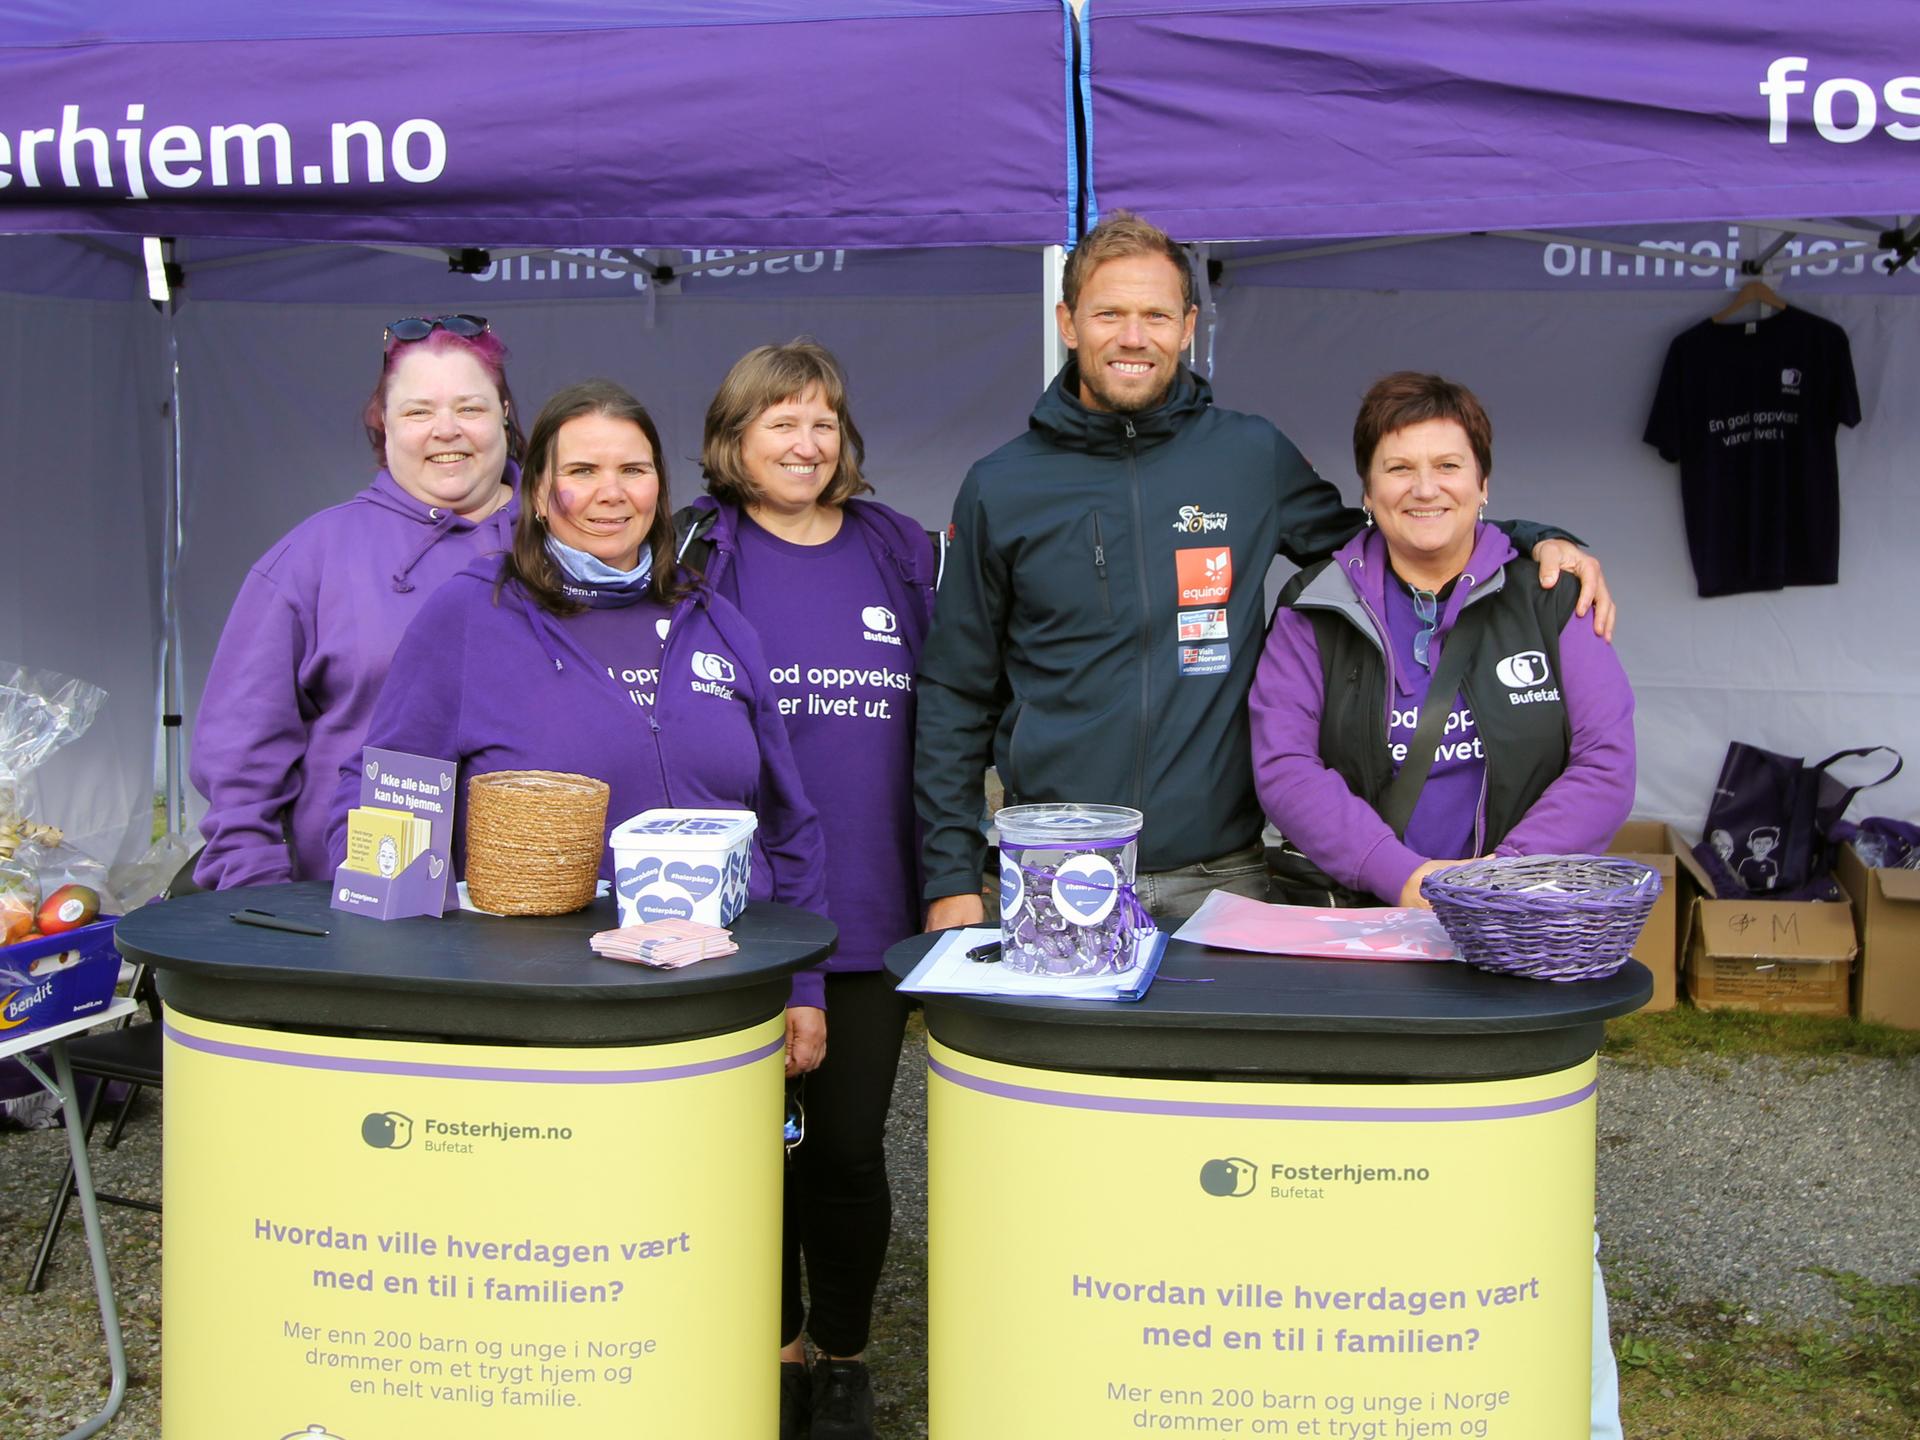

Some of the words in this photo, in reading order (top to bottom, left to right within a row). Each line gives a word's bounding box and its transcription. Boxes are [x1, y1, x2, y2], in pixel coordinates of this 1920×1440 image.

[1759, 56, 1920, 144] fos
[0, 104, 447, 199] rhjem.no
[1182, 585, 1229, 601] equinor
[863, 631, 902, 646] Bufetat
[691, 681, 734, 701] Bufetat
[807, 667, 912, 692] oppvekst
[808, 693, 859, 717] livet
[864, 698, 892, 720] ut.
[1508, 687, 1561, 706] Bufetat
[380, 773, 400, 788] Ikke
[401, 777, 418, 792] alle
[418, 780, 440, 796] barn
[374, 787, 391, 802] kan
[392, 790, 405, 805] bo
[405, 793, 444, 814] hjemme.
[9, 981, 53, 1018] Bendit
[424, 1118, 573, 1142] Fosterhjem.no
[424, 1140, 474, 1154] Bufetat
[1271, 1163, 1430, 1185] Fosterhjem.no
[1271, 1186, 1325, 1200] Bufetat
[254, 1217, 368, 1252] Hvordan
[377, 1231, 438, 1257] ville
[447, 1234, 610, 1268] hverdagen
[620, 1231, 691, 1261] vært
[312, 1269, 374, 1292] med
[383, 1275, 418, 1295] en
[428, 1274, 457, 1298] til
[467, 1276, 474, 1299] i
[484, 1277, 624, 1304] familien?
[1072, 1274, 1206, 1306] Hvordan
[1216, 1283, 1284, 1309] ville
[1295, 1285, 1466, 1316] hverdagen
[1476, 1277, 1540, 1307] vært
[283, 1320, 322, 1341] Mer
[328, 1329, 366, 1346] enn
[373, 1329, 412, 1350] 200
[419, 1332, 468, 1353] barn
[475, 1340, 502, 1360] og
[511, 1342, 567, 1362] unge
[574, 1340, 579, 1358] i
[588, 1338, 657, 1360] Norge
[1143, 1324, 1212, 1348] med
[1223, 1330, 1262, 1350] en
[1272, 1327, 1305, 1352] til
[1316, 1328, 1323, 1352] i
[1335, 1327, 1480, 1353] familien?
[305, 1347, 403, 1373] drømmer
[409, 1360, 443, 1376] om
[450, 1360, 472, 1378] et
[479, 1361, 533, 1385] trygt
[541, 1364, 596, 1386] hjem
[604, 1366, 632, 1385] og
[350, 1378, 375, 1395] en
[383, 1378, 423, 1399] helt
[430, 1385, 494, 1408] vanlig
[501, 1386, 582, 1407] familie.
[1107, 1382, 1153, 1402] Mer
[1159, 1388, 1203, 1406] enn
[1211, 1388, 1254, 1408] 200
[1262, 1389, 1316, 1410] barn
[1324, 1394, 1354, 1415] og
[1363, 1396, 1423, 1416] unge
[1431, 1391, 1435, 1411] i
[1444, 1389, 1510, 1412] Norge
[1133, 1409, 1244, 1433] drømmer
[1251, 1418, 1289, 1435] om
[1296, 1417, 1321, 1436] et
[1328, 1417, 1388, 1440] trygt
[1395, 1417, 1451, 1440] hjem
[1460, 1418, 1488, 1438] og
